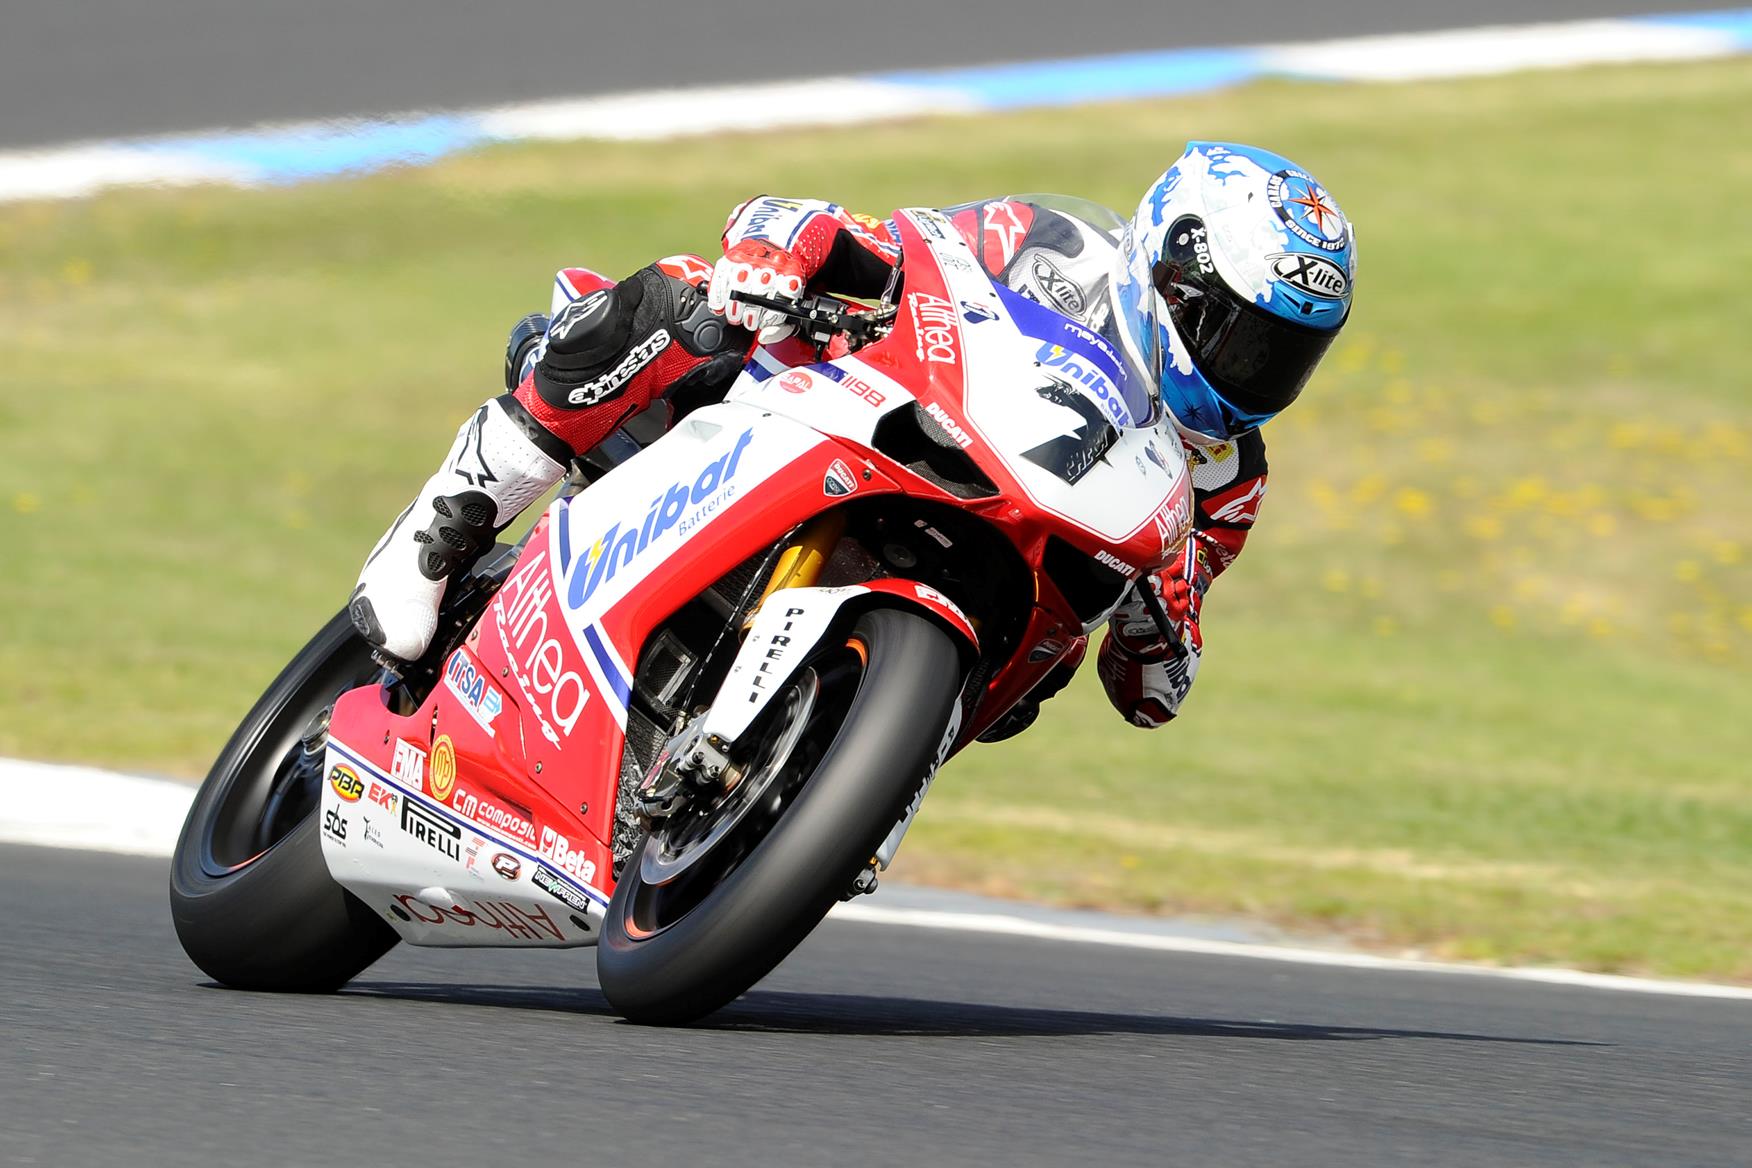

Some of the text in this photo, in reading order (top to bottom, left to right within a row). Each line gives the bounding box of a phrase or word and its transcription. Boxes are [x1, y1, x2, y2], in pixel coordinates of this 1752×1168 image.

[1190, 226, 1214, 275] X-802
[1281, 255, 1343, 293] X-lite
[841, 375, 887, 408] 1198
[1035, 341, 1129, 427] Unibat
[926, 402, 974, 448] DUCATI
[833, 463, 855, 490] DUCATI
[567, 427, 754, 610] Unibat
[678, 484, 736, 537] Batterie
[1094, 550, 1136, 578] DUCATI
[503, 550, 590, 737] Althea
[748, 607, 805, 704] PIRELLI
[327, 765, 365, 800] PBR
[452, 788, 478, 819] CM
[400, 795, 462, 862] PIRELLI
[555, 834, 597, 885] Beta
